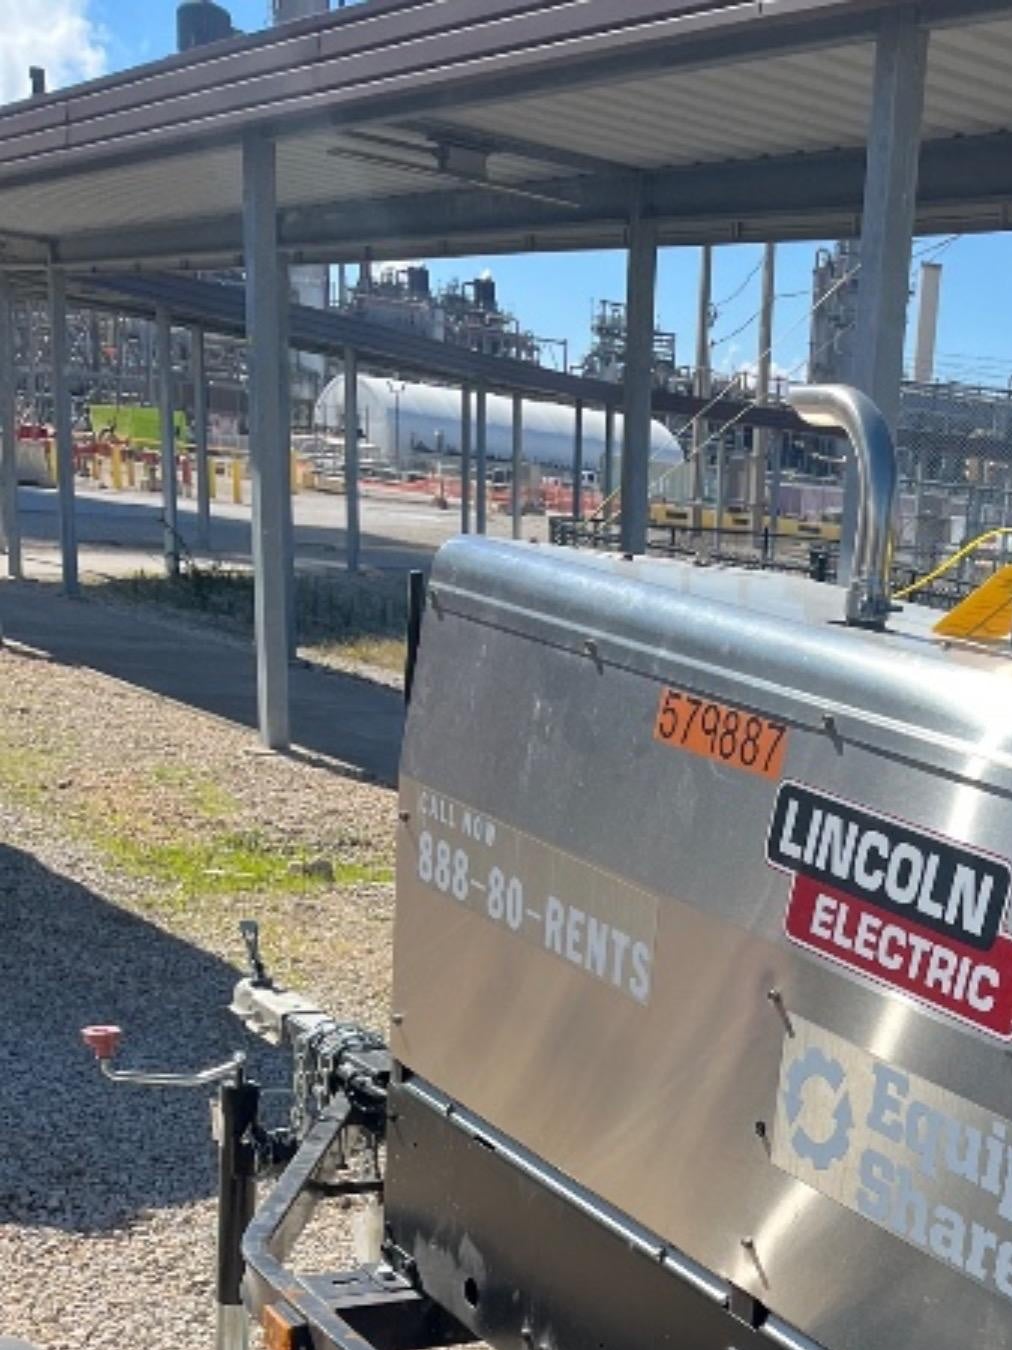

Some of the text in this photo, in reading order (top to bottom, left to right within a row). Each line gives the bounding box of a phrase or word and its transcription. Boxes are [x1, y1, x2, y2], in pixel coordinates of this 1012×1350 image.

[658, 690, 787, 772] 579887
[421, 790, 455, 830] CALL
[779, 799, 995, 937] LINCOLN
[418, 831, 650, 1006] 888-80-RENTS
[809, 893, 1000, 1012] ELECTRIC
